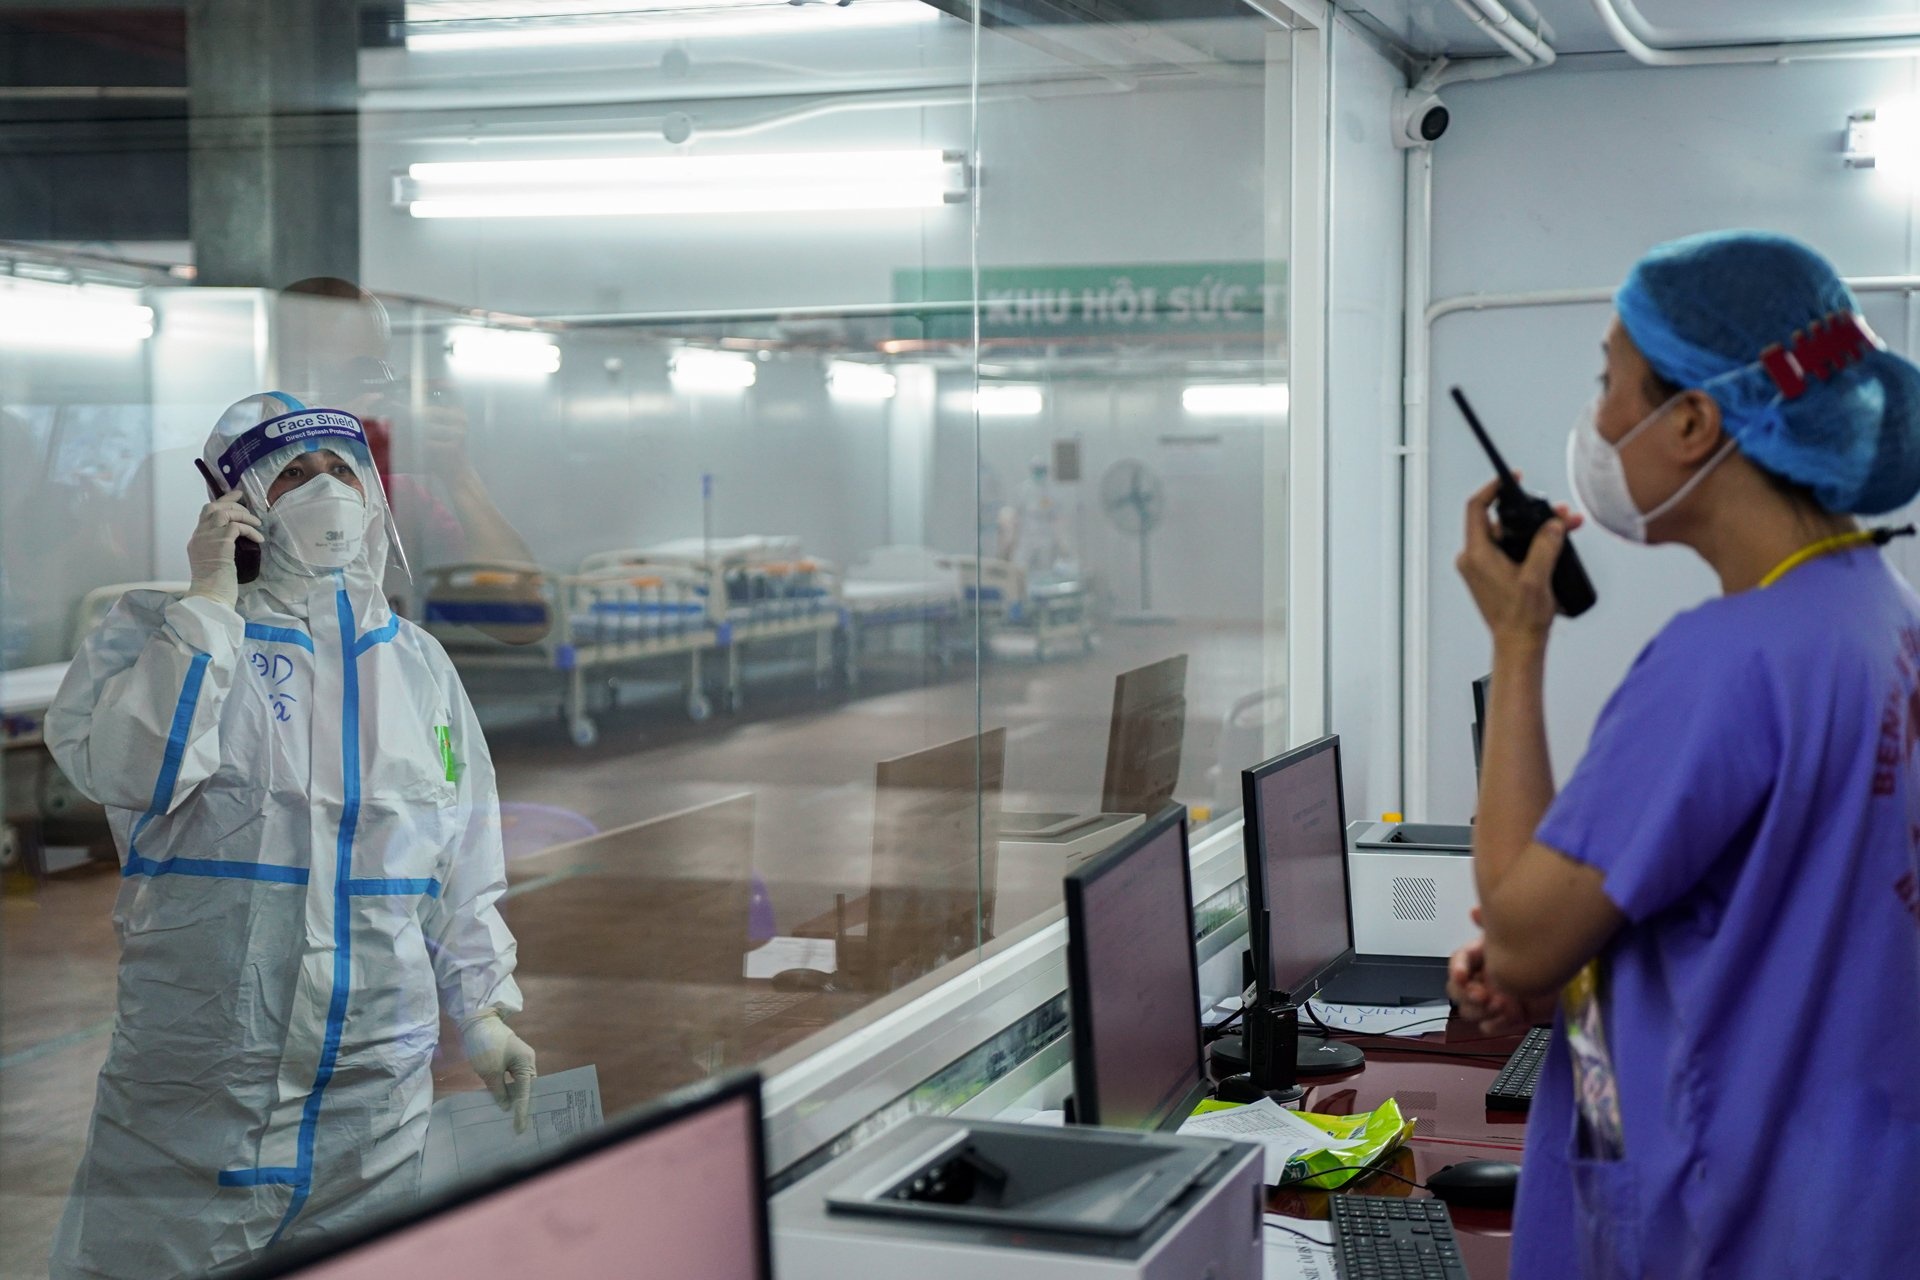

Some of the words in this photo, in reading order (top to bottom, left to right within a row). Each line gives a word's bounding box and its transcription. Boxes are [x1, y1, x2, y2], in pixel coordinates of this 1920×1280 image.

[986, 286, 1072, 325] KHU
[277, 417, 314, 434] Face
[316, 413, 355, 429] Shield
[285, 431, 306, 442] Direct
[306, 428, 329, 437] Splash
[329, 428, 357, 438] Protection
[325, 530, 344, 541] 3M
